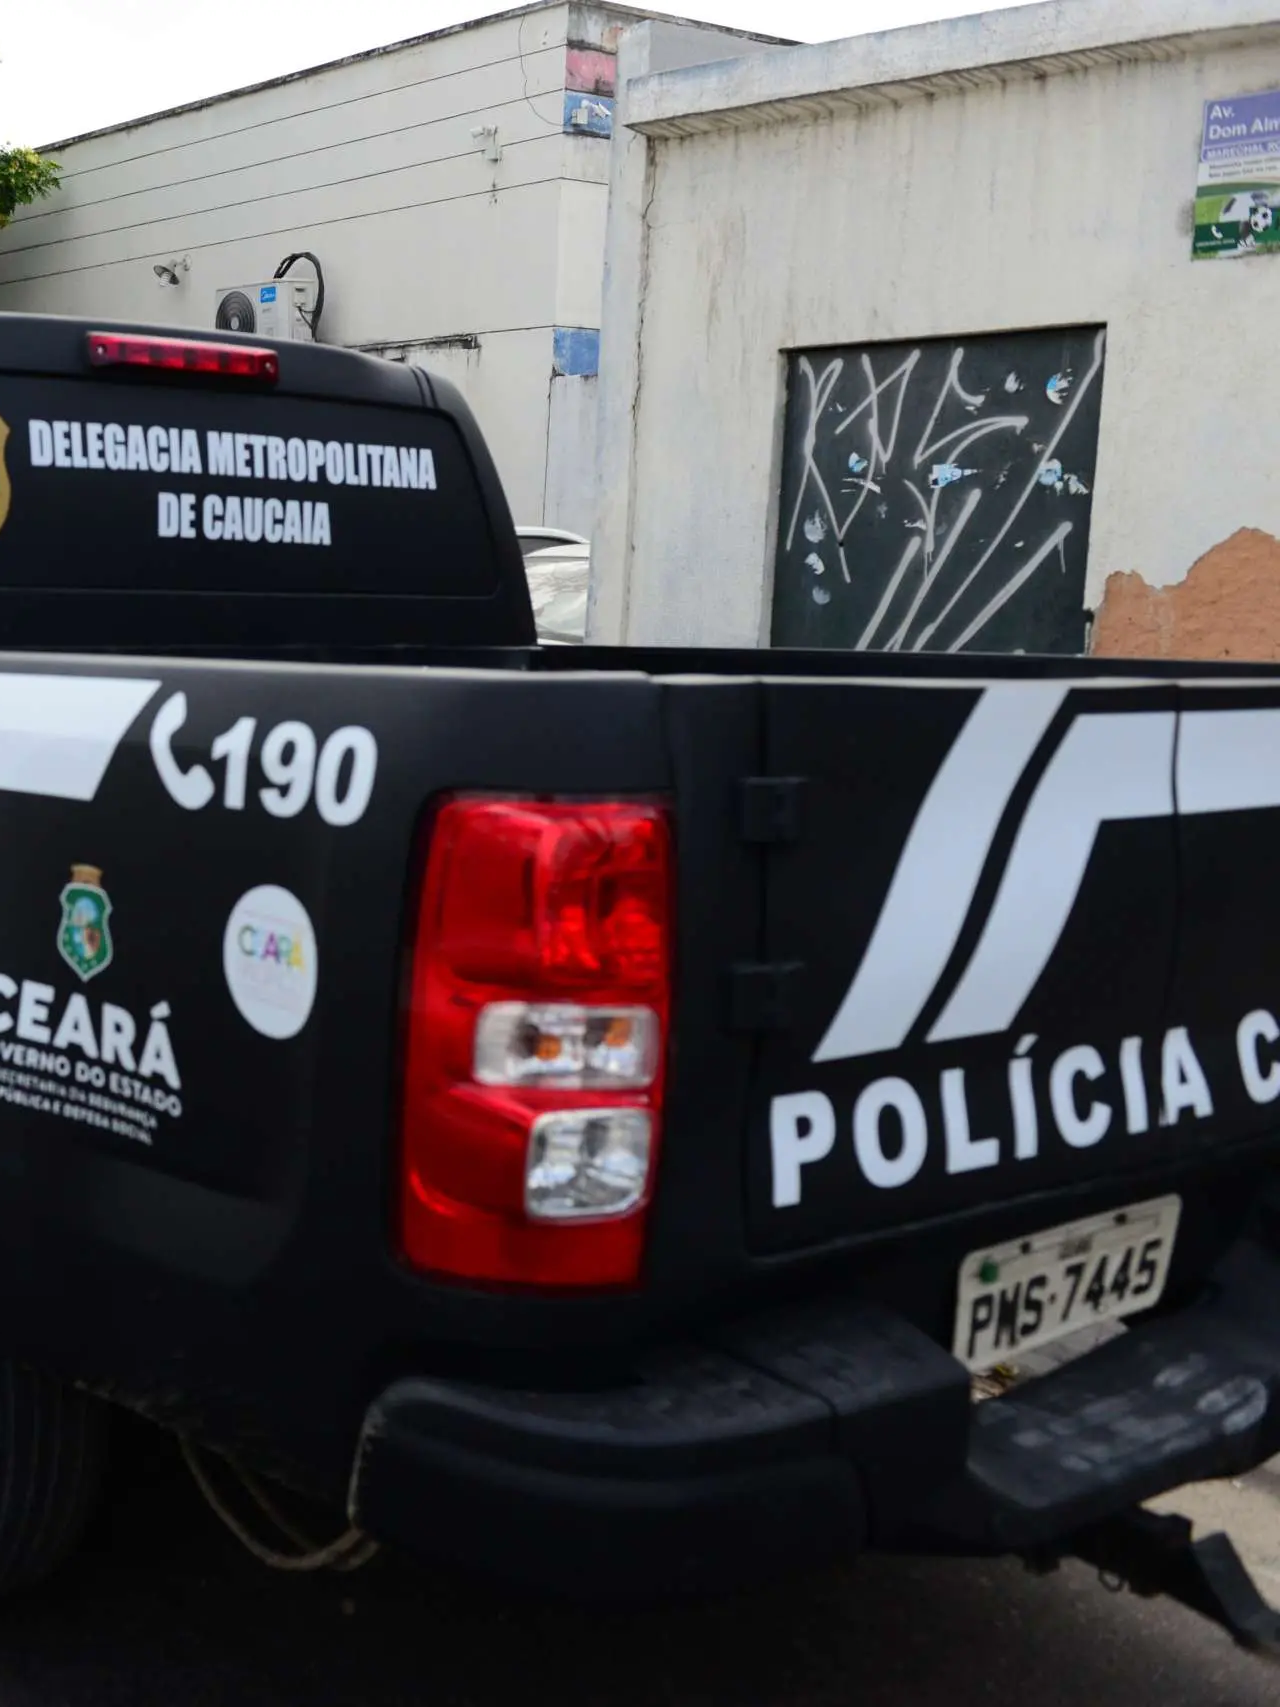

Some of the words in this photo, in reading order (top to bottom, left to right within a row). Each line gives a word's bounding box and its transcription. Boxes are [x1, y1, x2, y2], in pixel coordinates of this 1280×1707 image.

[1209, 122, 1248, 140] Dom
[28, 419, 202, 474] DELEGACIA
[207, 431, 437, 490] METROPOLITANA
[158, 492, 196, 538] DE
[202, 494, 331, 545] CAUCAIA
[211, 716, 378, 826] 190
[75, 1061, 106, 1088] DO
[109, 1071, 182, 1118] ESTADO
[770, 1025, 1213, 1208] POLÍCIA
